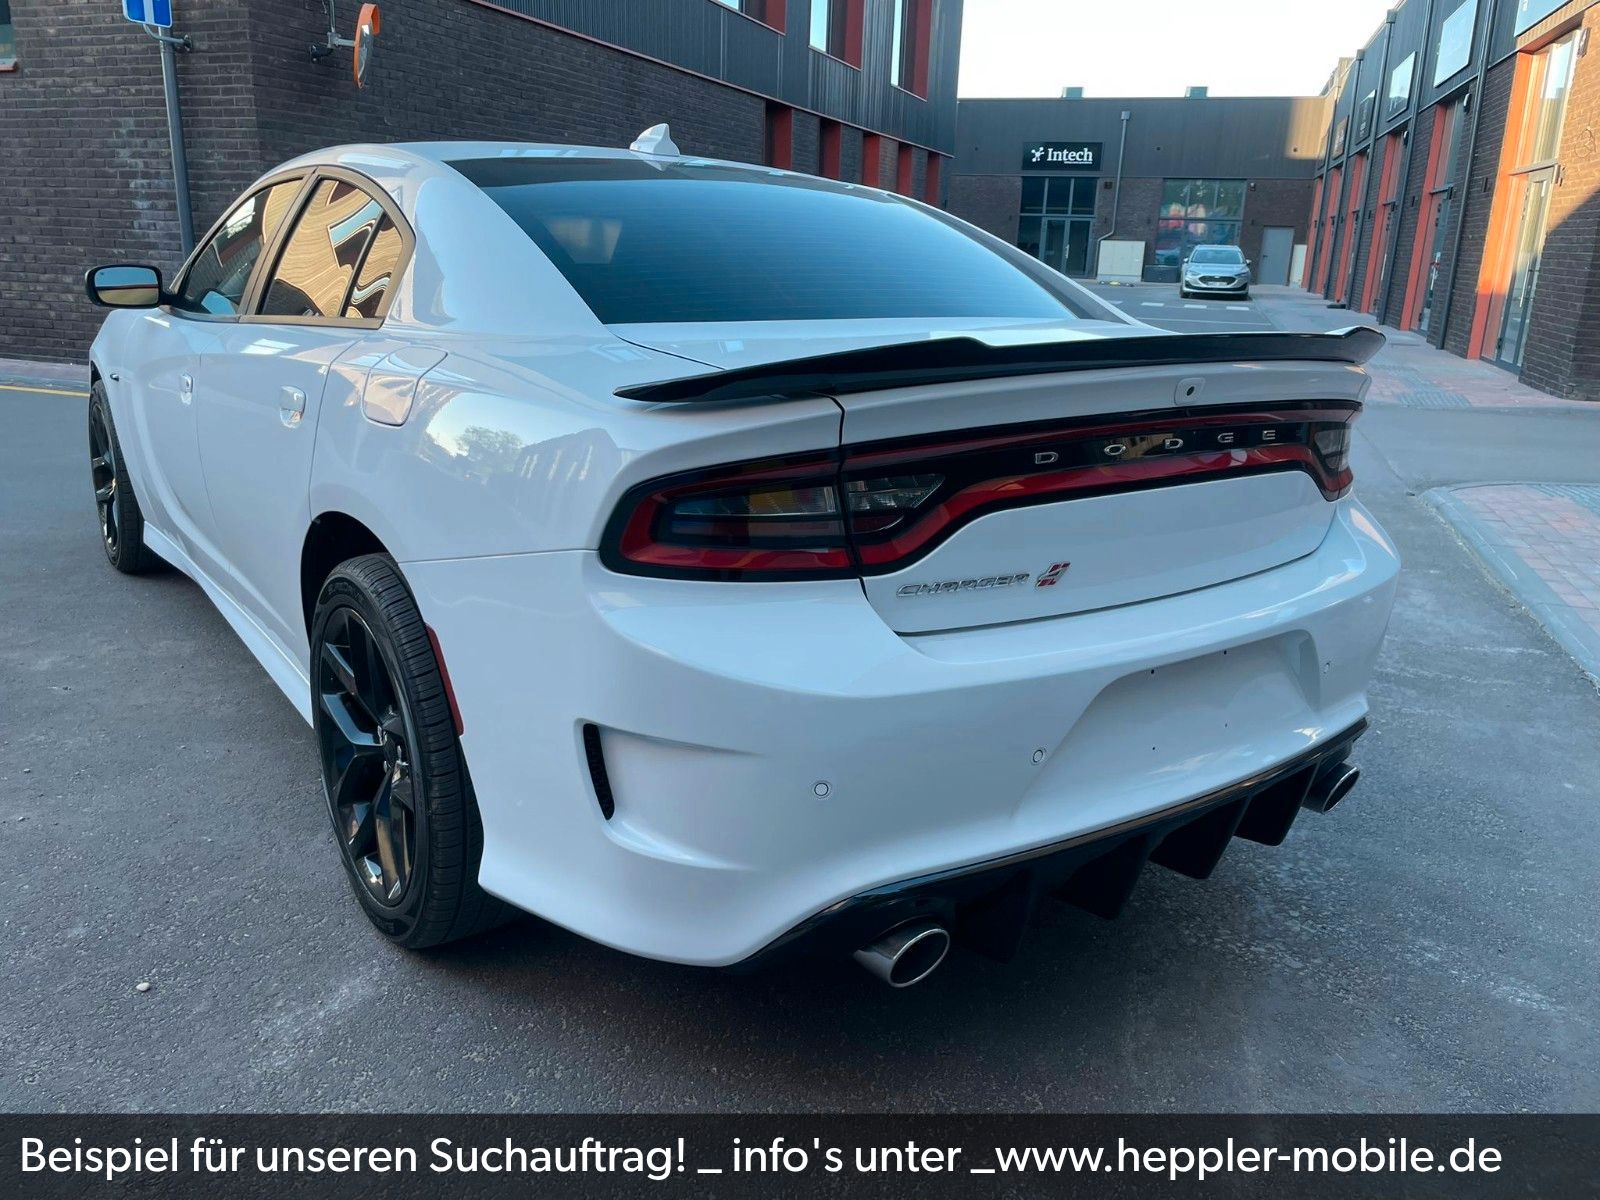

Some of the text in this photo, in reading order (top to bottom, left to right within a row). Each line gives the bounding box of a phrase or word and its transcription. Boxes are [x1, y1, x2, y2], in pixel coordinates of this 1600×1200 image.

[1047, 147, 1093, 161] Intech
[1035, 429, 1277, 465] DODGE
[897, 573, 1030, 597] CHARGER
